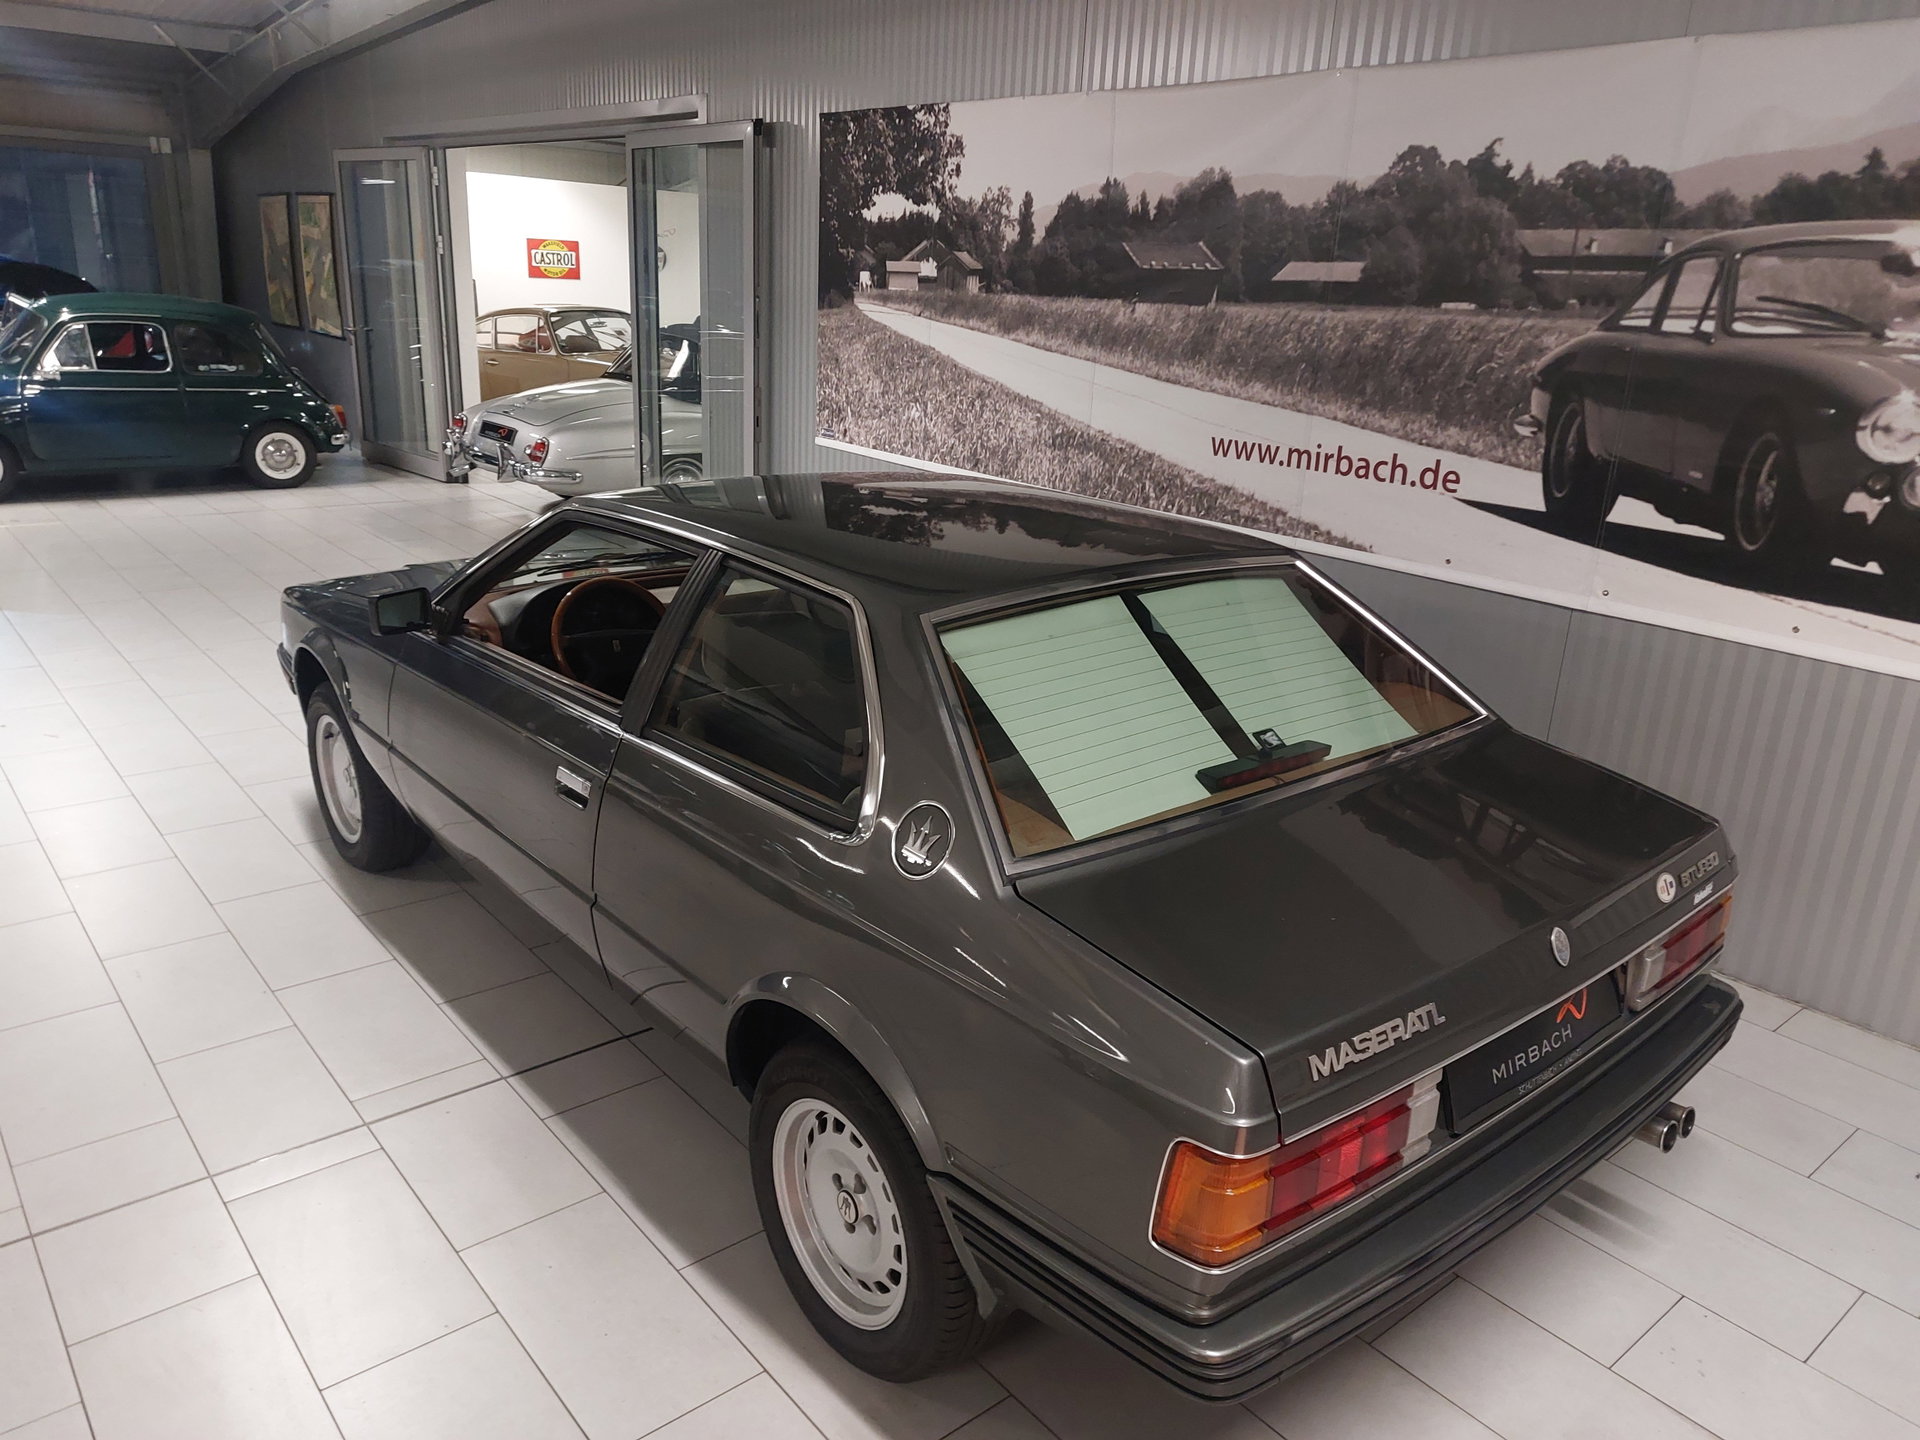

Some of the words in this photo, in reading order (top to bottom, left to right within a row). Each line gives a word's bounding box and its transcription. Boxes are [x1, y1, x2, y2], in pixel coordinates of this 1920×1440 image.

[533, 251, 575, 266] CASTROL
[1211, 436, 1461, 494] www.mirbach.de
[1491, 1023, 1573, 1085] MIRBACH
